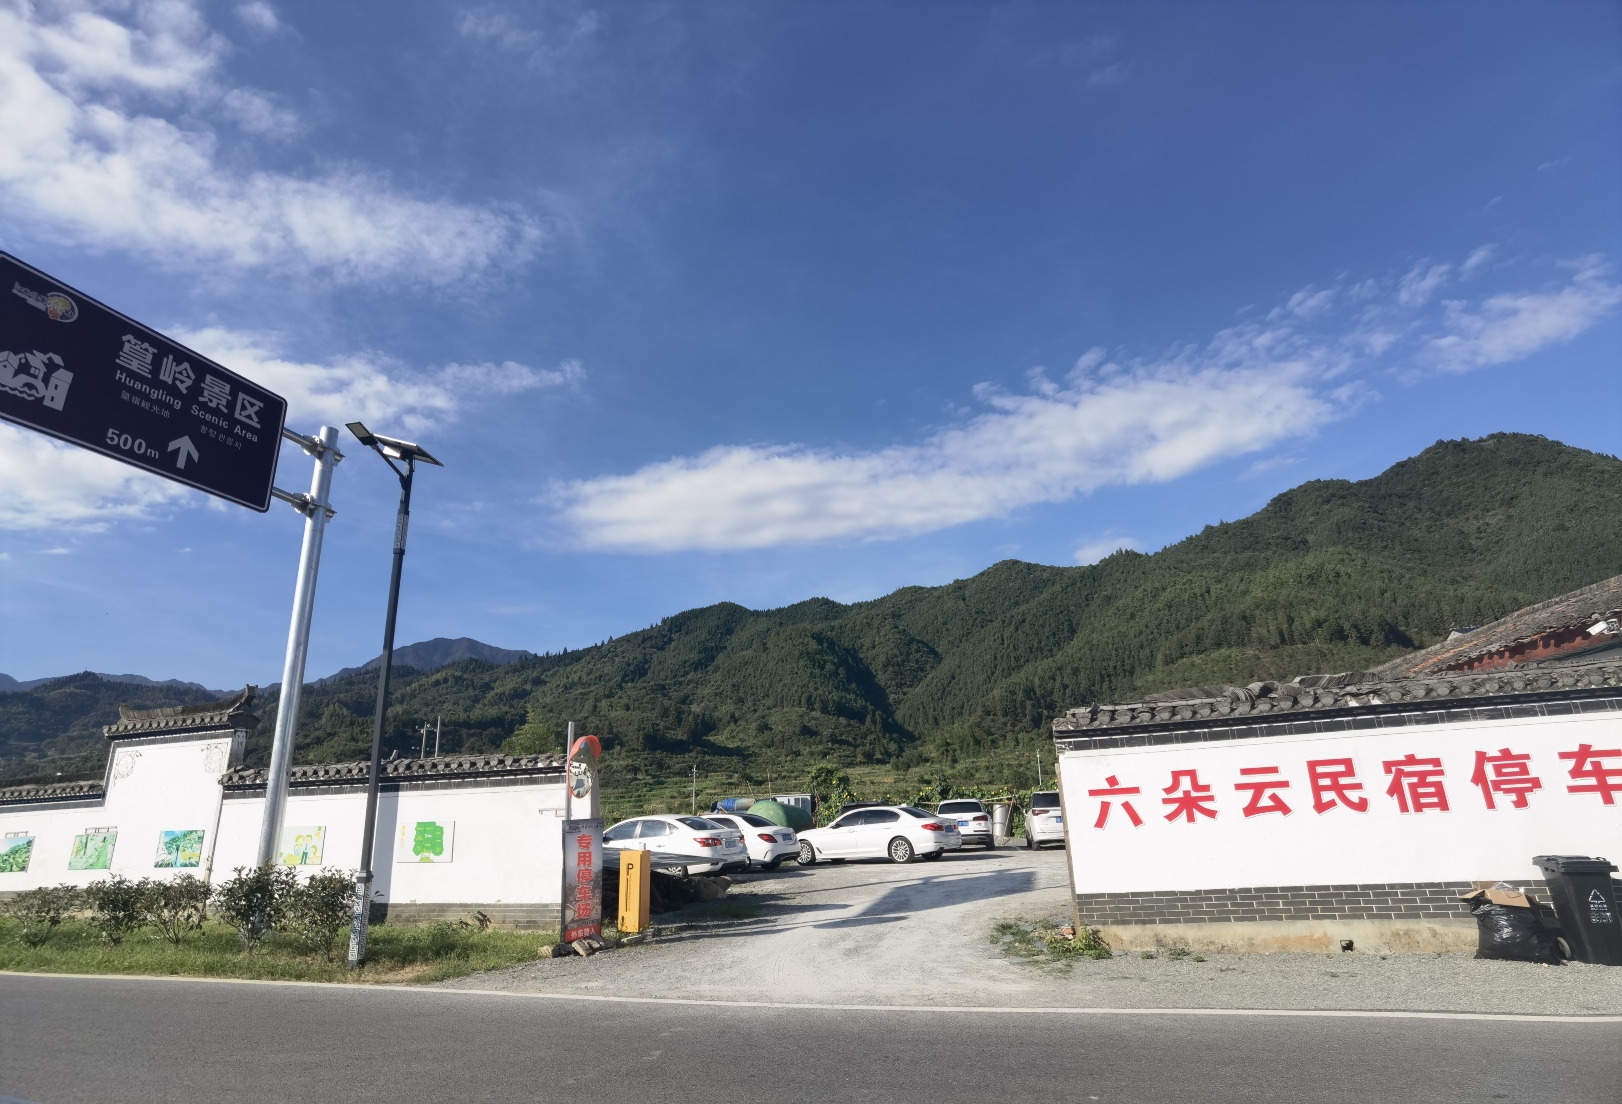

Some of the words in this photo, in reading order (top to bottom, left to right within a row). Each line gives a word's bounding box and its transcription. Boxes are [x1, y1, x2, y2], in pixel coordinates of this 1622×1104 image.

[115, 334, 264, 429] 篁岭景区
[116, 370, 182, 410] Huangling
[191, 404, 229, 429] Scenic
[233, 424, 259, 443] Area
[105, 428, 159, 460] 500m
[576, 833, 593, 919] 专用停车场
[626, 863, 634, 876] P
